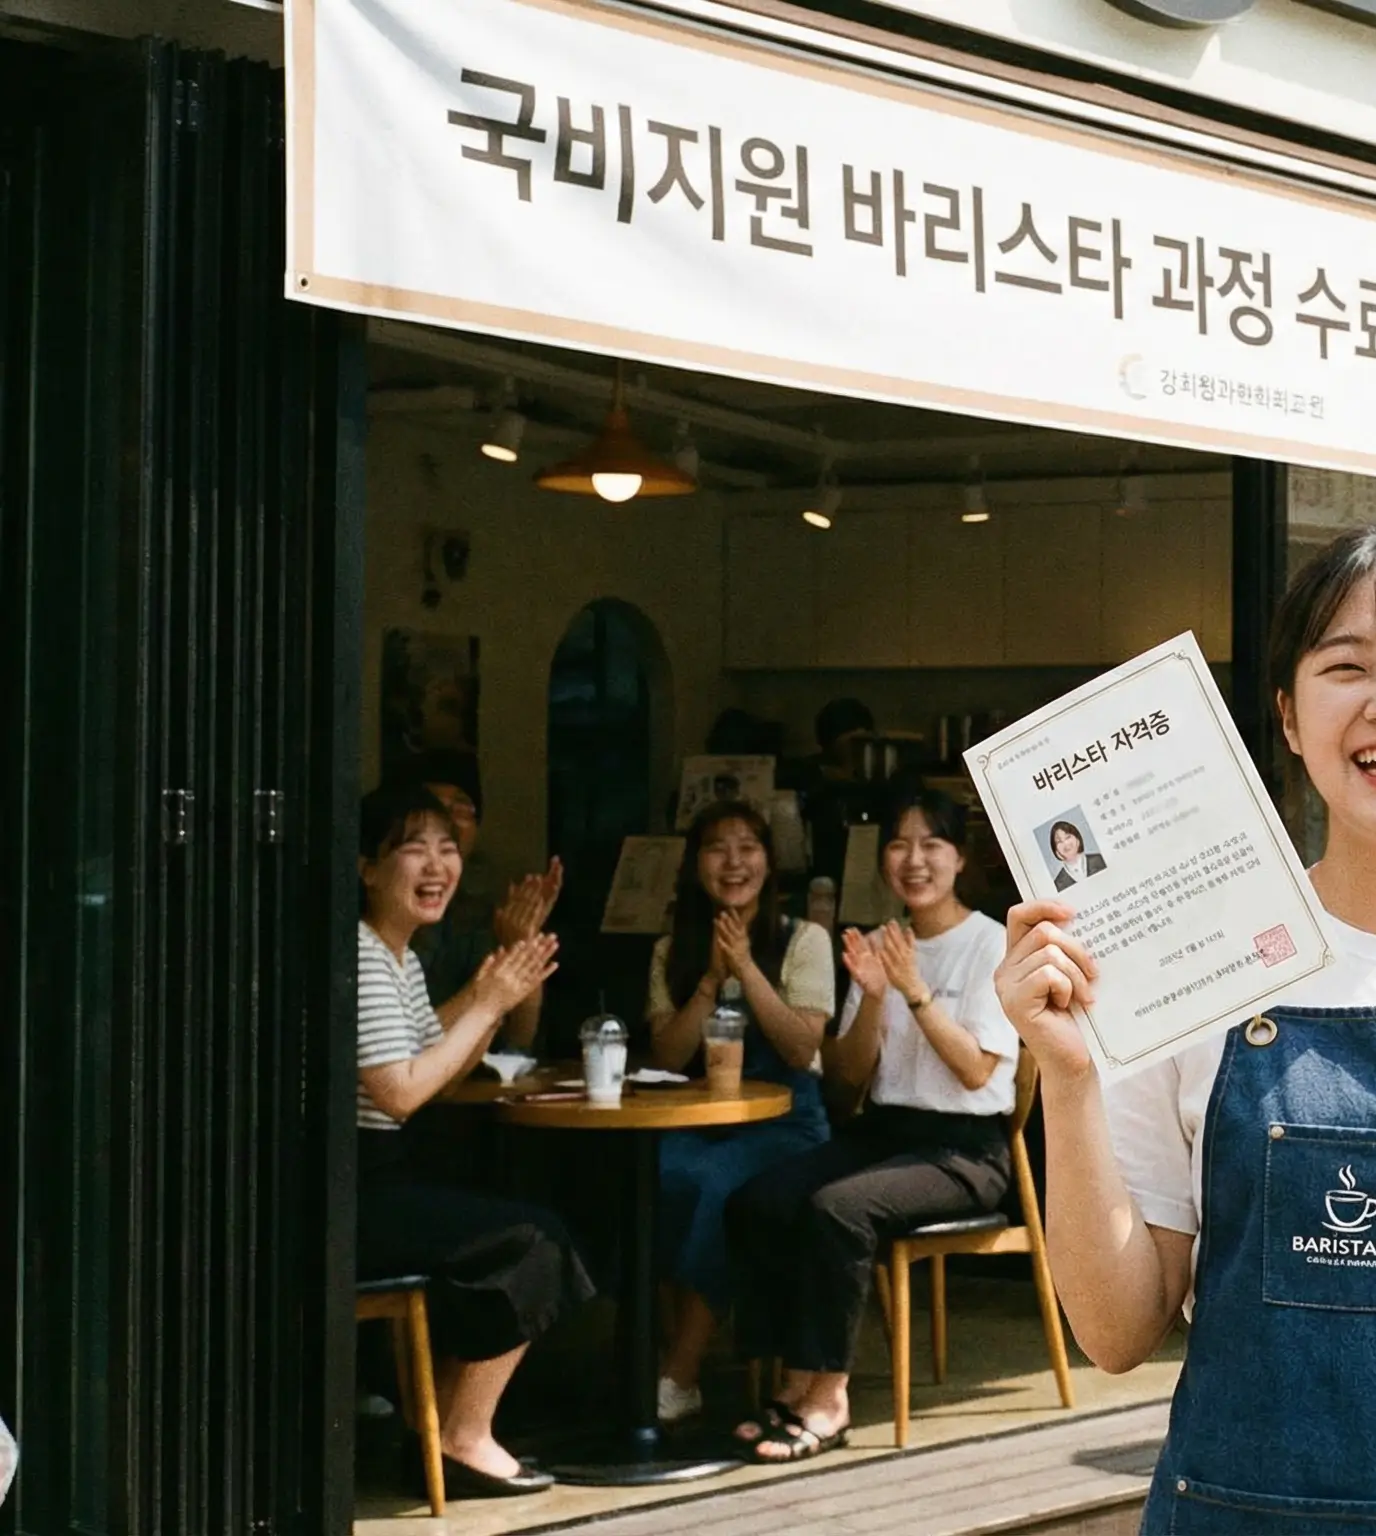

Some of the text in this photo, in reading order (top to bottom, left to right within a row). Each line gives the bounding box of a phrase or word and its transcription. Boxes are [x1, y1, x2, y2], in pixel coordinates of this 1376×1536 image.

[447, 67, 813, 257] 국비지원
[842, 163, 1132, 320] 바리스타
[1152, 235, 1273, 346] 과정
[1032, 739, 1108, 792] 바리스타
[1110, 709, 1170, 751] 자격증
